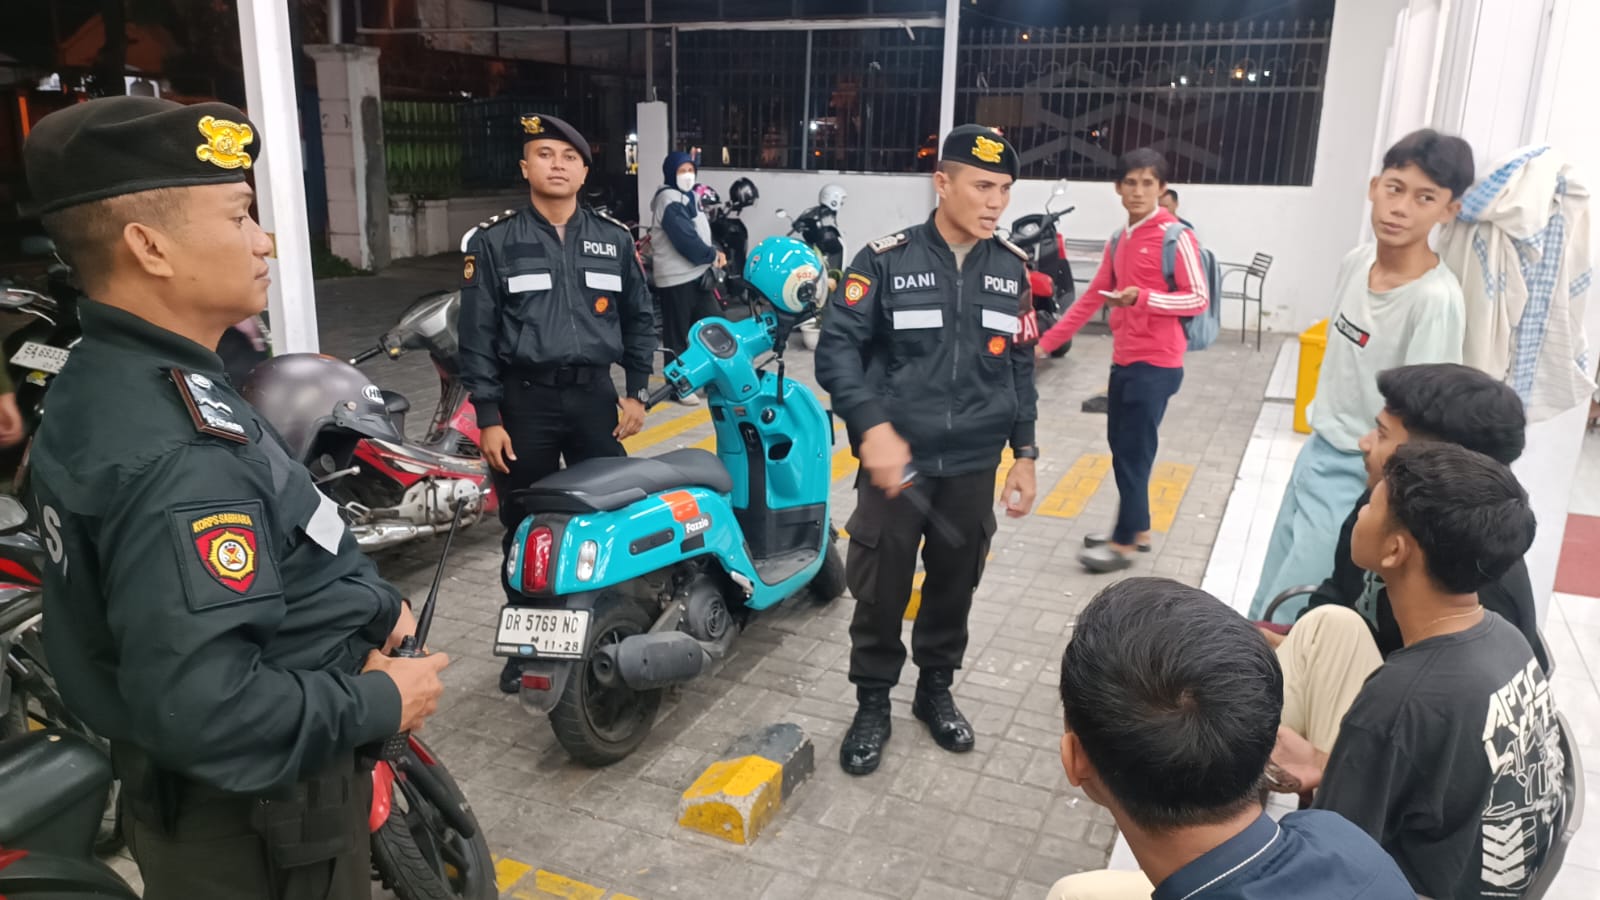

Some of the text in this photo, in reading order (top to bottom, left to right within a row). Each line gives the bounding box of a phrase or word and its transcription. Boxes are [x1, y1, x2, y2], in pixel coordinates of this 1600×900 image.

[583, 240, 617, 257] POLRI
[893, 272, 935, 290] DANI
[984, 275, 1018, 295] POLRI
[505, 614, 579, 633] DR 5769 NC
